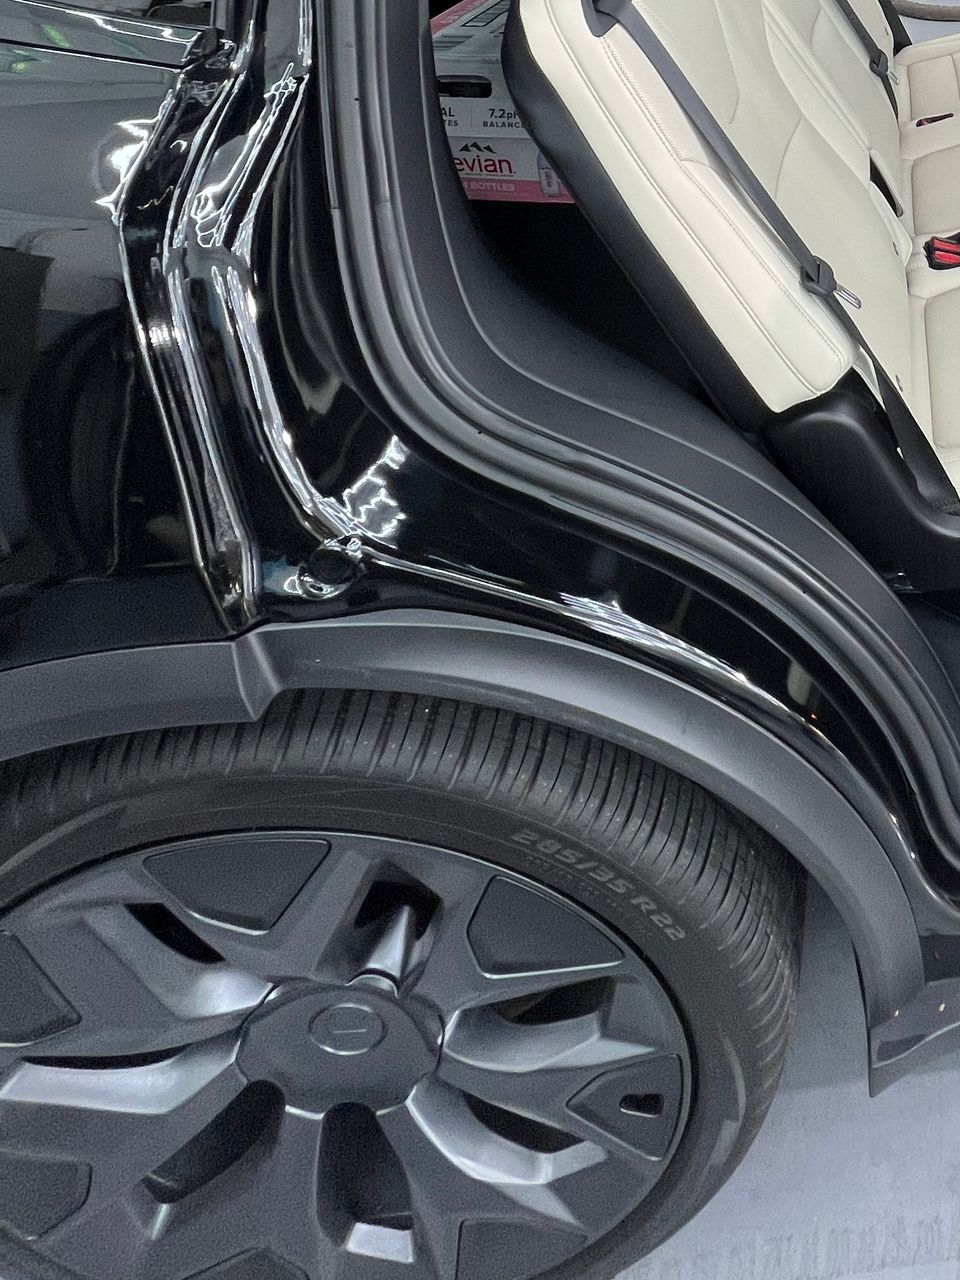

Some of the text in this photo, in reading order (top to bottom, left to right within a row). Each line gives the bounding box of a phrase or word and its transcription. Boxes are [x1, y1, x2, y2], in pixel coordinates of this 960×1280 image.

[453, 155, 514, 174] evian
[470, 182, 516, 193] BOTTLES
[511, 829, 634, 894] 285/35
